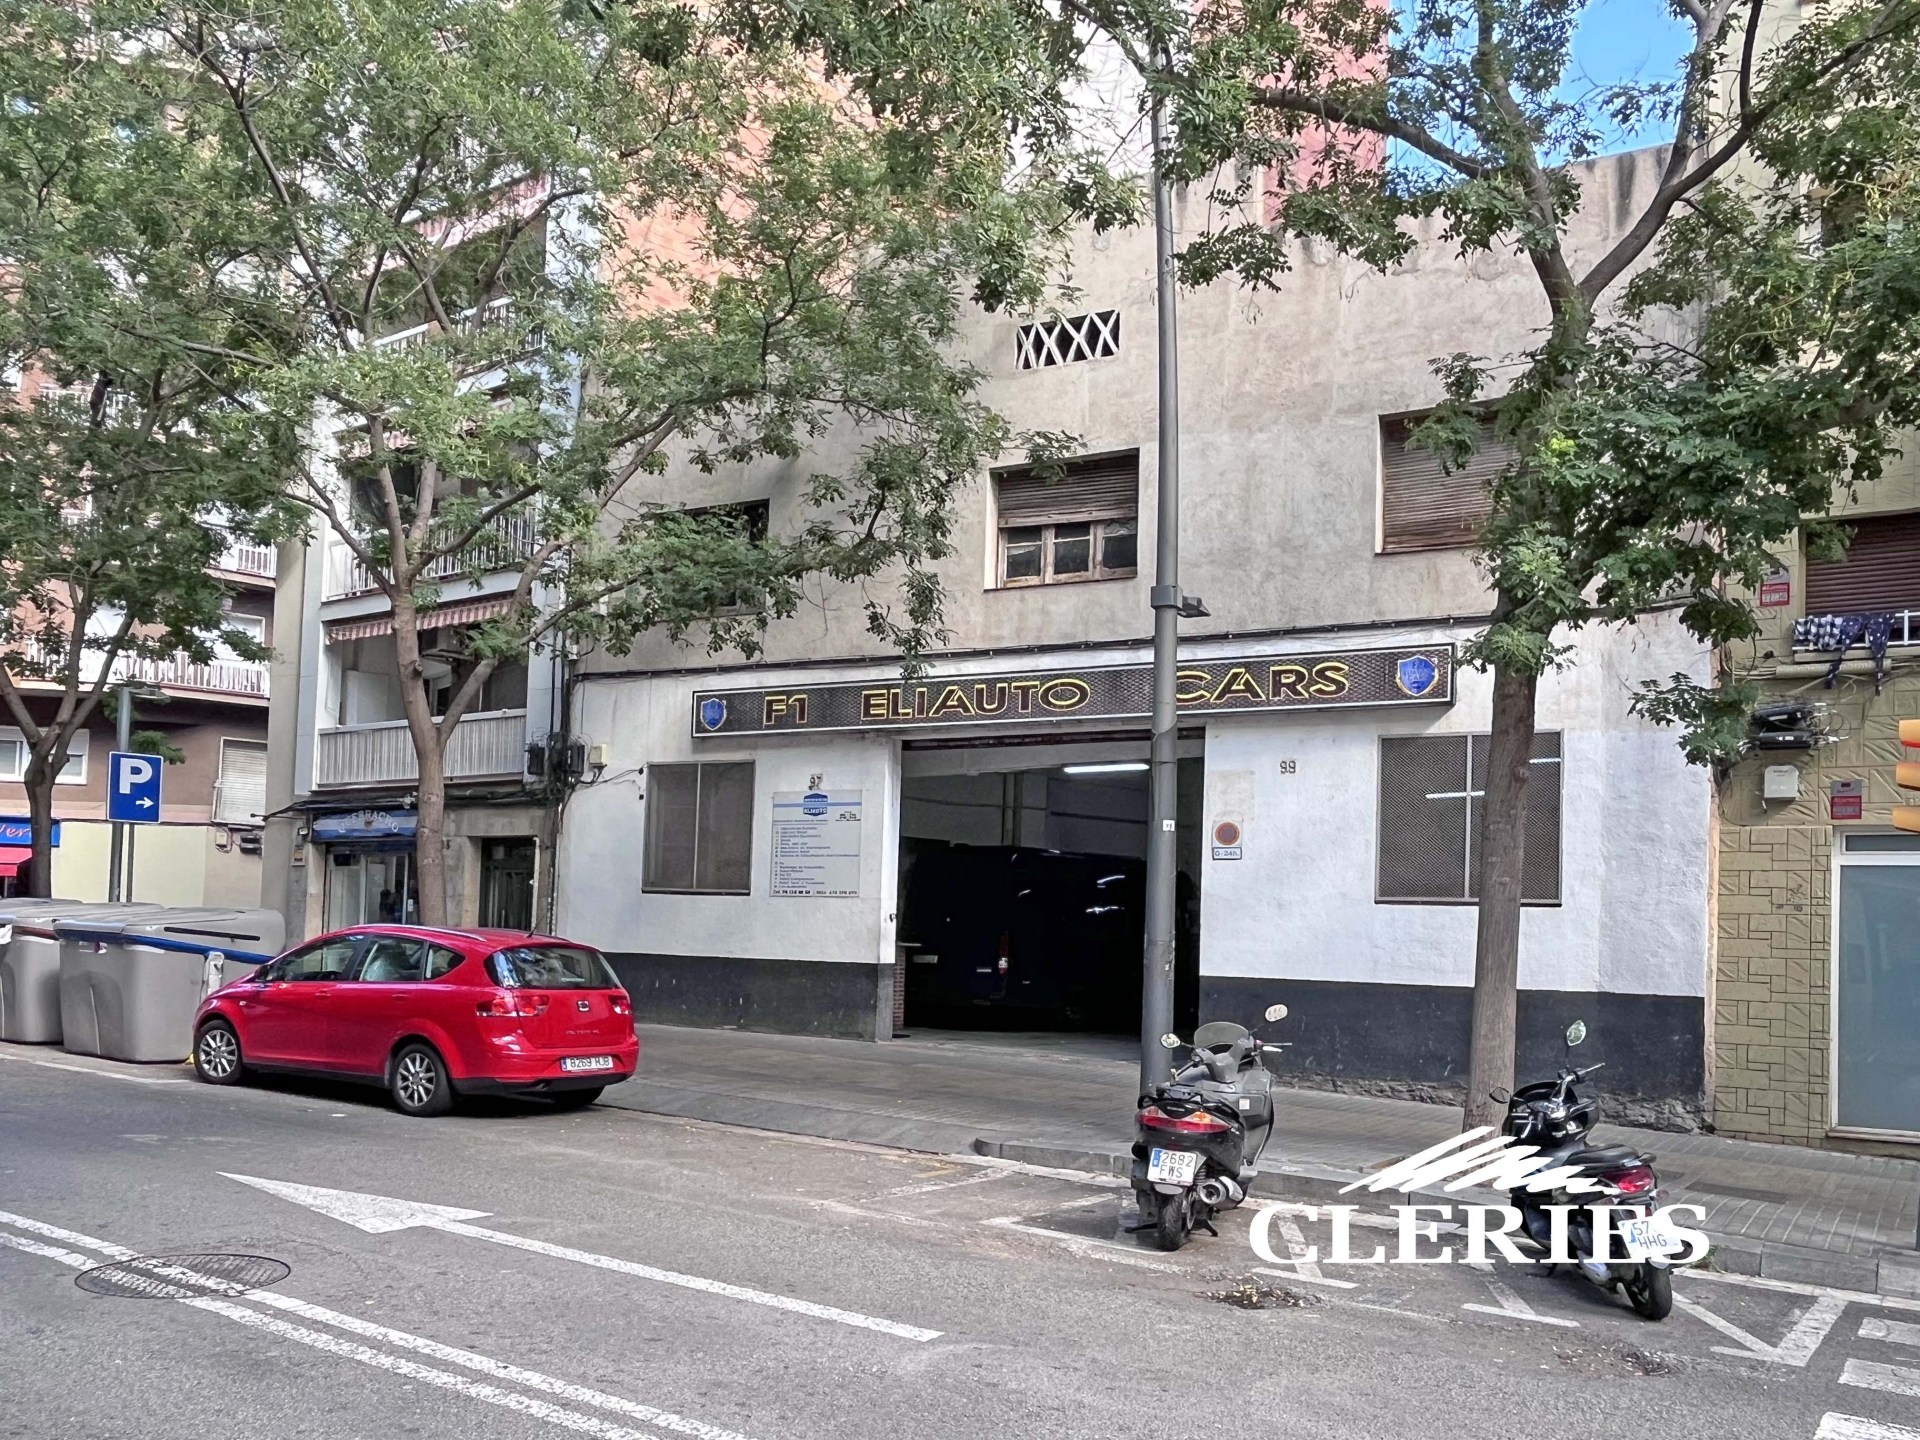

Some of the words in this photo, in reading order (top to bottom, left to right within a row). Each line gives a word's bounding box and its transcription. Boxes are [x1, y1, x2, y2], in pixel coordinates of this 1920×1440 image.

[763, 694, 808, 725] F1
[860, 678, 1091, 720] ELIAUTO
[1176, 661, 1350, 706] CARS
[119, 757, 153, 794] P
[1159, 1164, 1184, 1179] FWS
[1161, 1152, 1194, 1168] 2682
